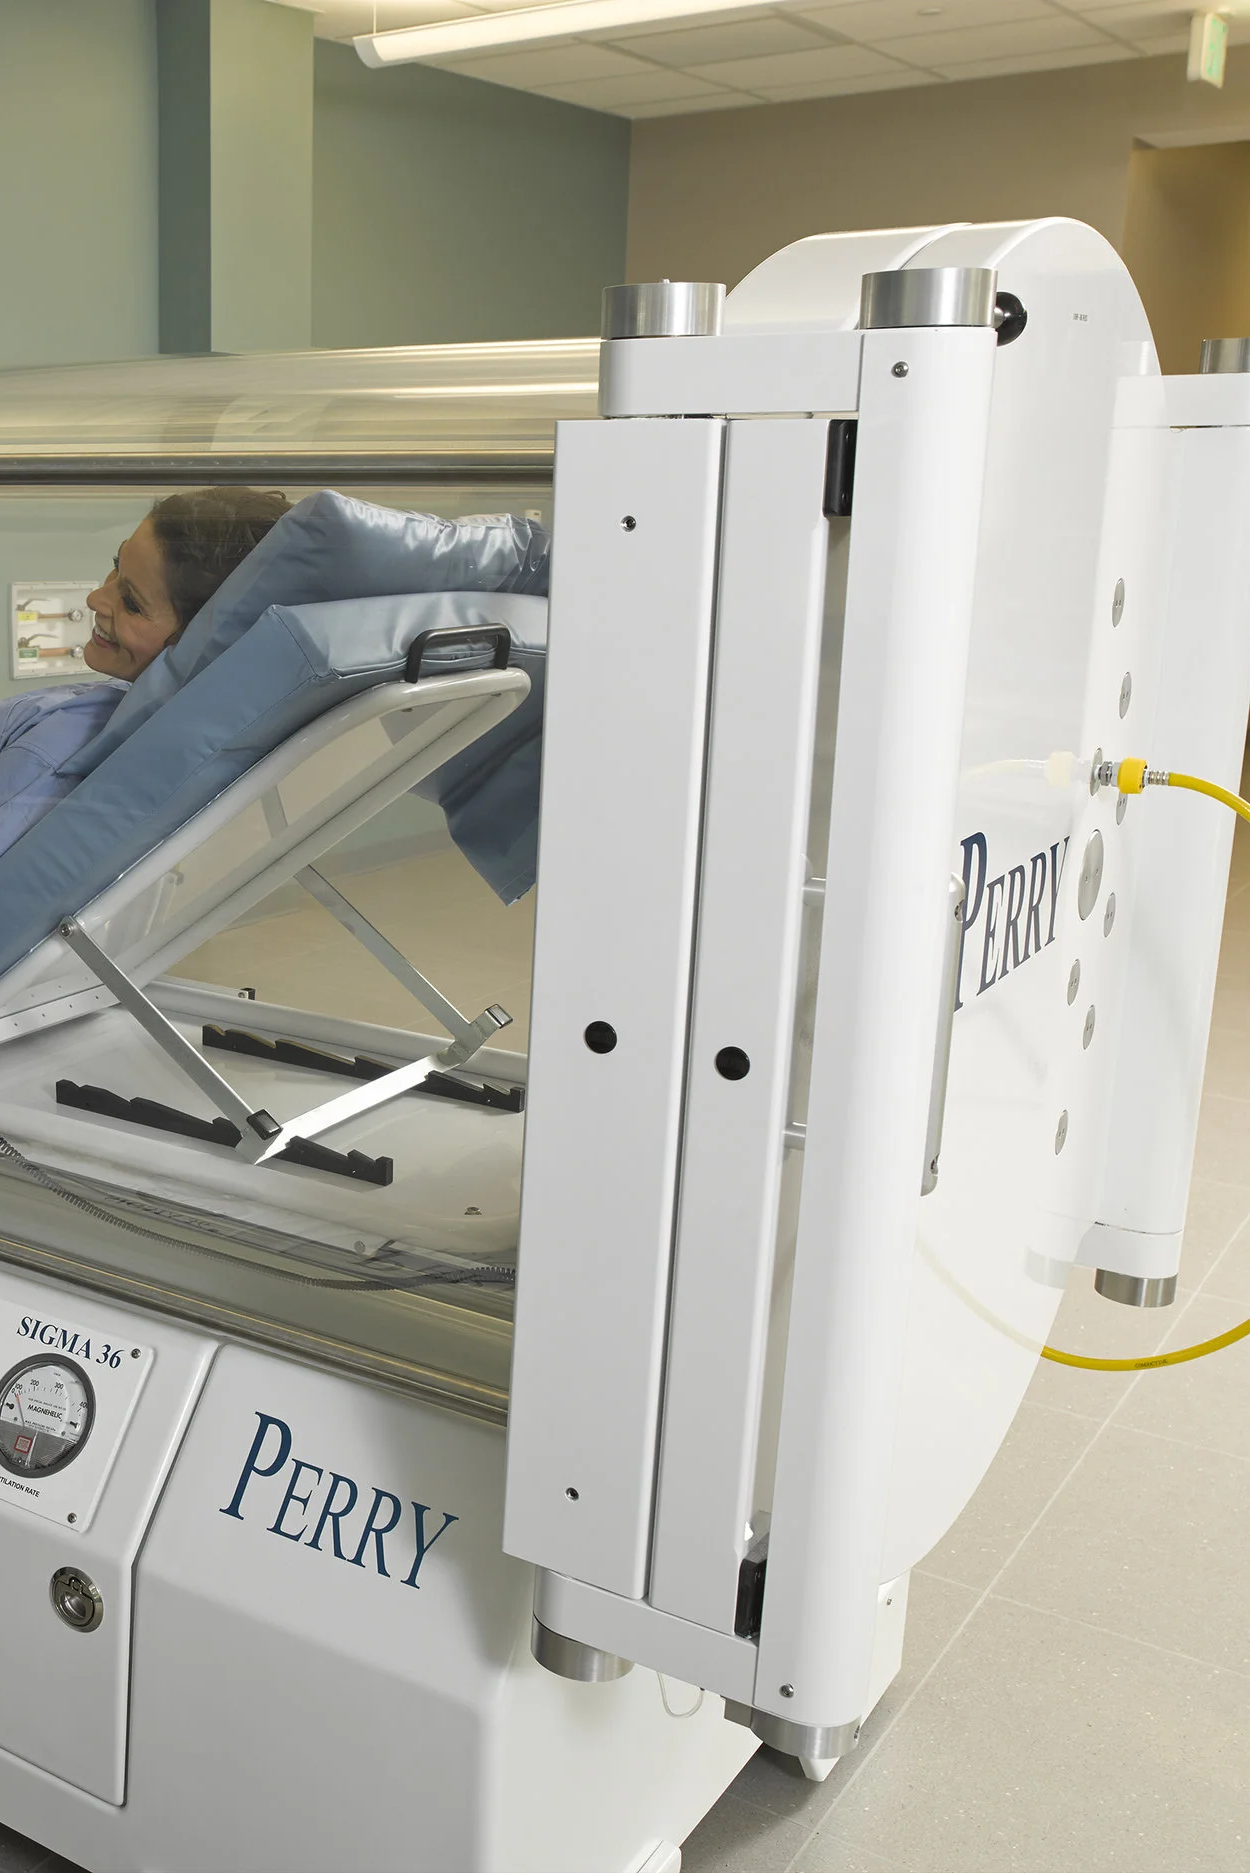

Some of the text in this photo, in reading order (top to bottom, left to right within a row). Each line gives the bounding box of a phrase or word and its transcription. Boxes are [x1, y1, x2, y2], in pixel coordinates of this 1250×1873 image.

[16, 1315, 125, 1369] SIGMA 36
[14, 1382, 23, 1390] 100
[30, 1379, 40, 1387] 200
[53, 1381, 65, 1391] 300
[24, 1486, 41, 1498] RATE
[218, 1410, 460, 1590] PERRY
